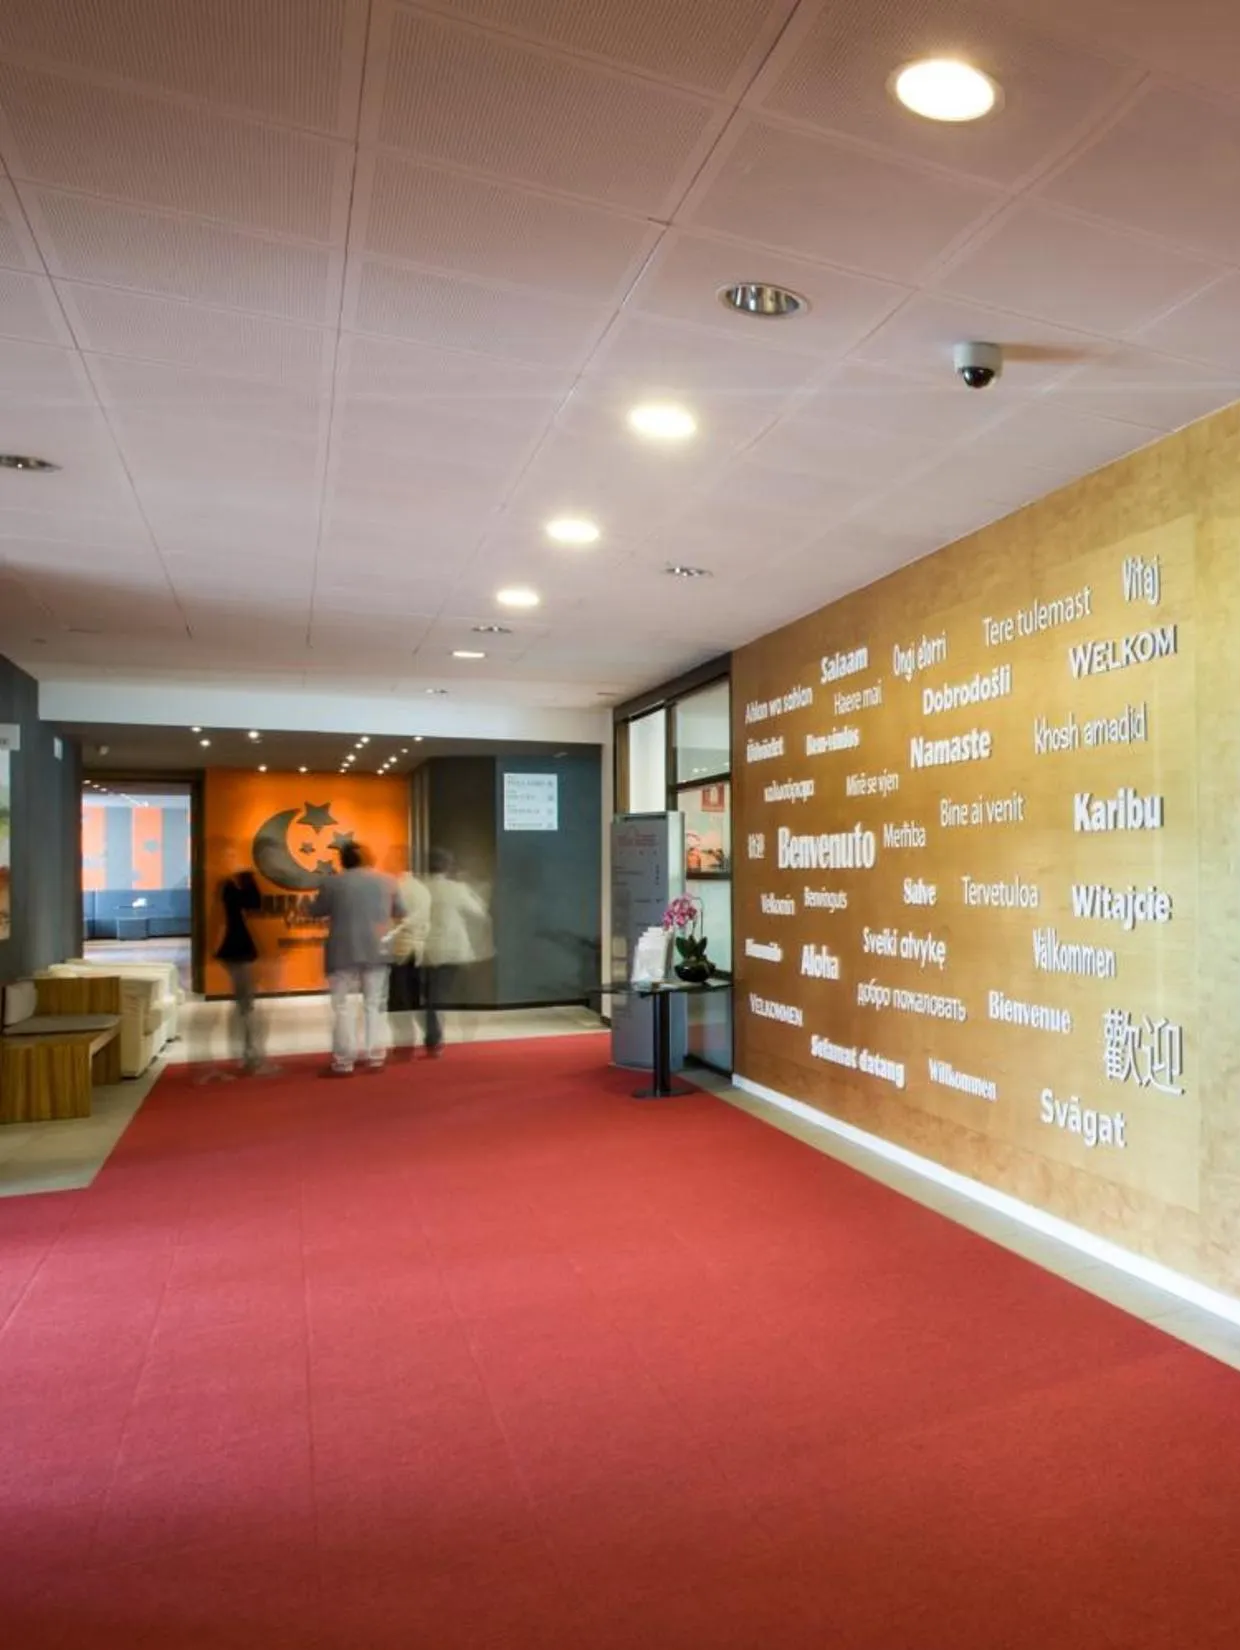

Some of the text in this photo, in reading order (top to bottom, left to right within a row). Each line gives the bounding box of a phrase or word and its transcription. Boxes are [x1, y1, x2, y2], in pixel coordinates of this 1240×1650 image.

[1122, 556, 1160, 604] Vitaj
[983, 586, 1092, 645] Tere tulemast
[821, 647, 868, 684] Salaam
[893, 645, 916, 681] Ongi
[1068, 624, 1174, 678] WELKOM
[922, 664, 1010, 715] Dobrodošli
[911, 728, 991, 767] Namaste
[940, 793, 1023, 826] Bine ai venit
[1073, 788, 1162, 832] Karibu
[778, 822, 876, 868] Benvenuto
[904, 878, 936, 905] Salve
[961, 875, 1039, 908] Tervetuloa
[1072, 883, 1172, 931] Witajcie
[801, 944, 839, 979] Aloha
[989, 991, 1071, 1034] Bienvenue
[859, 1049, 905, 1088] datang
[929, 1058, 997, 1101] Willkommen
